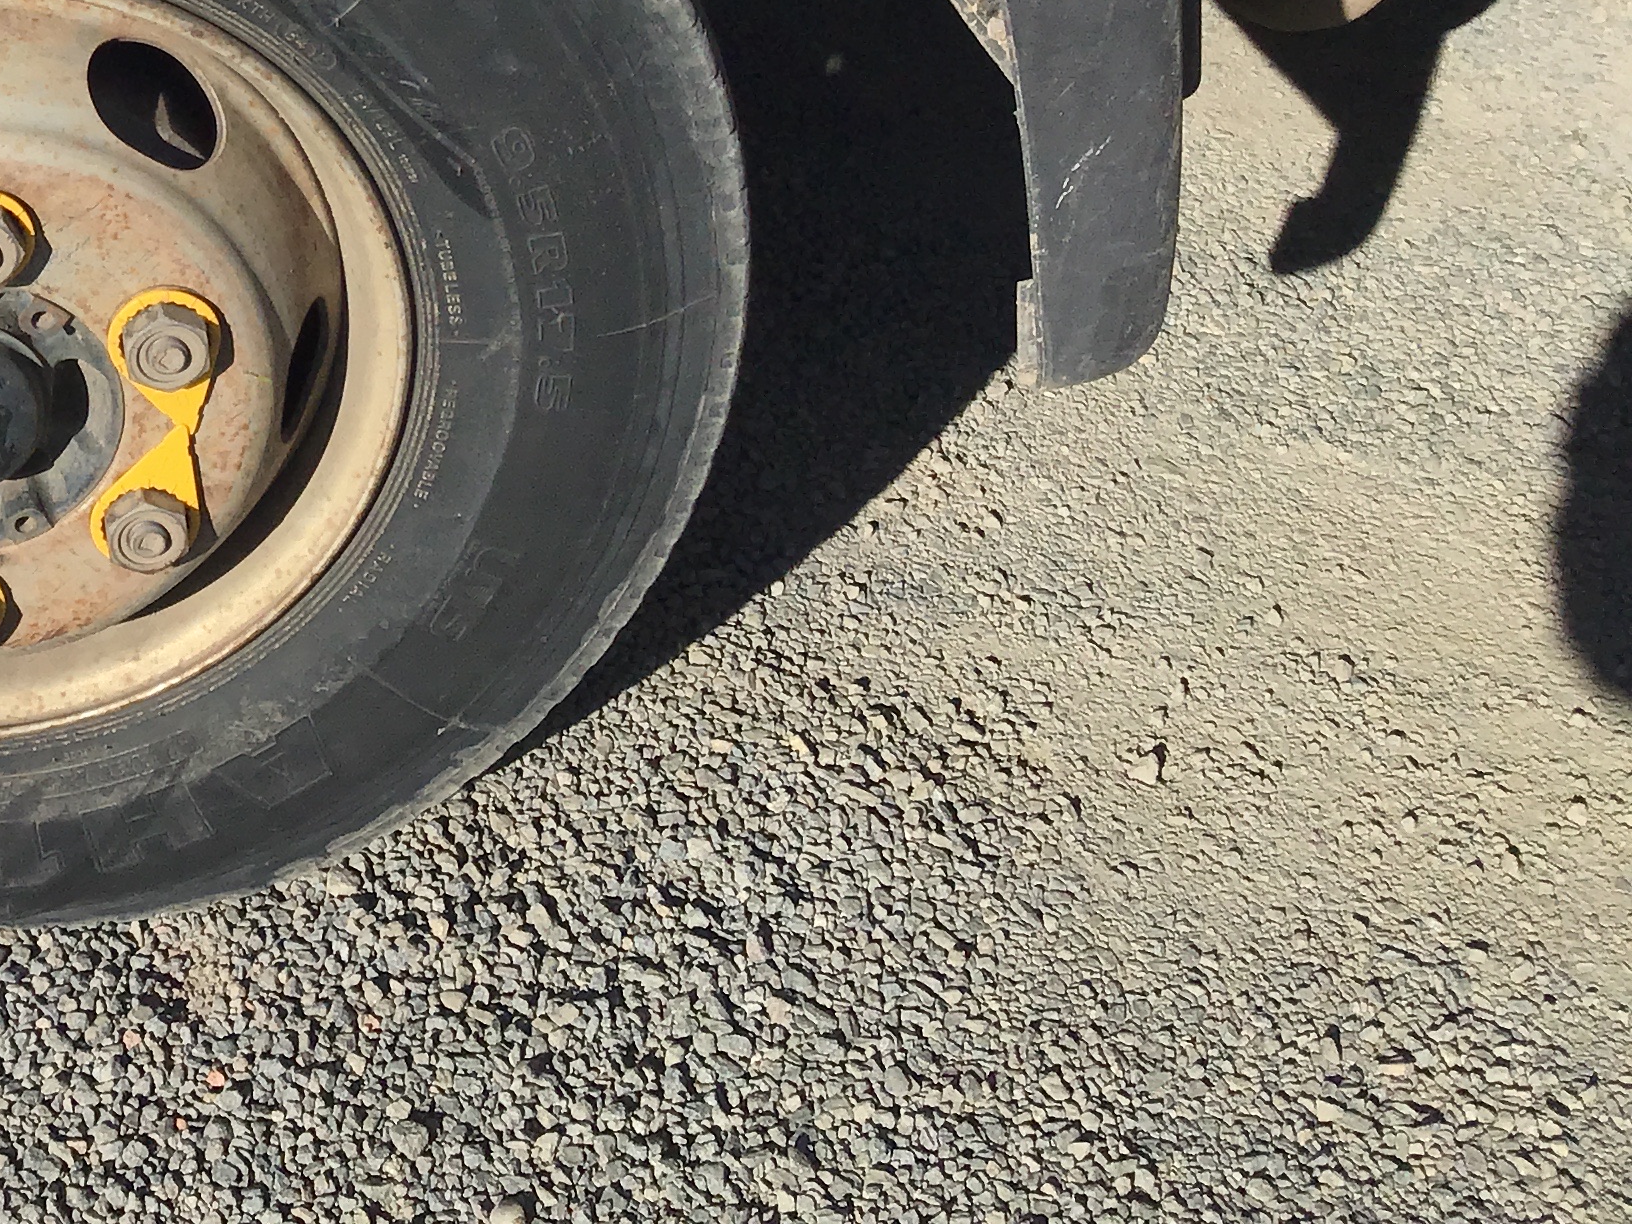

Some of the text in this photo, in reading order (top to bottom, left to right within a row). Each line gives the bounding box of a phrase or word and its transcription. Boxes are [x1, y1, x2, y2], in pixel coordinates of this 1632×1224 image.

[489, 125, 578, 412] 9.5R17.5
[412, 387, 457, 501] REGROOVABLE
[342, 550, 392, 605] RADIAL
